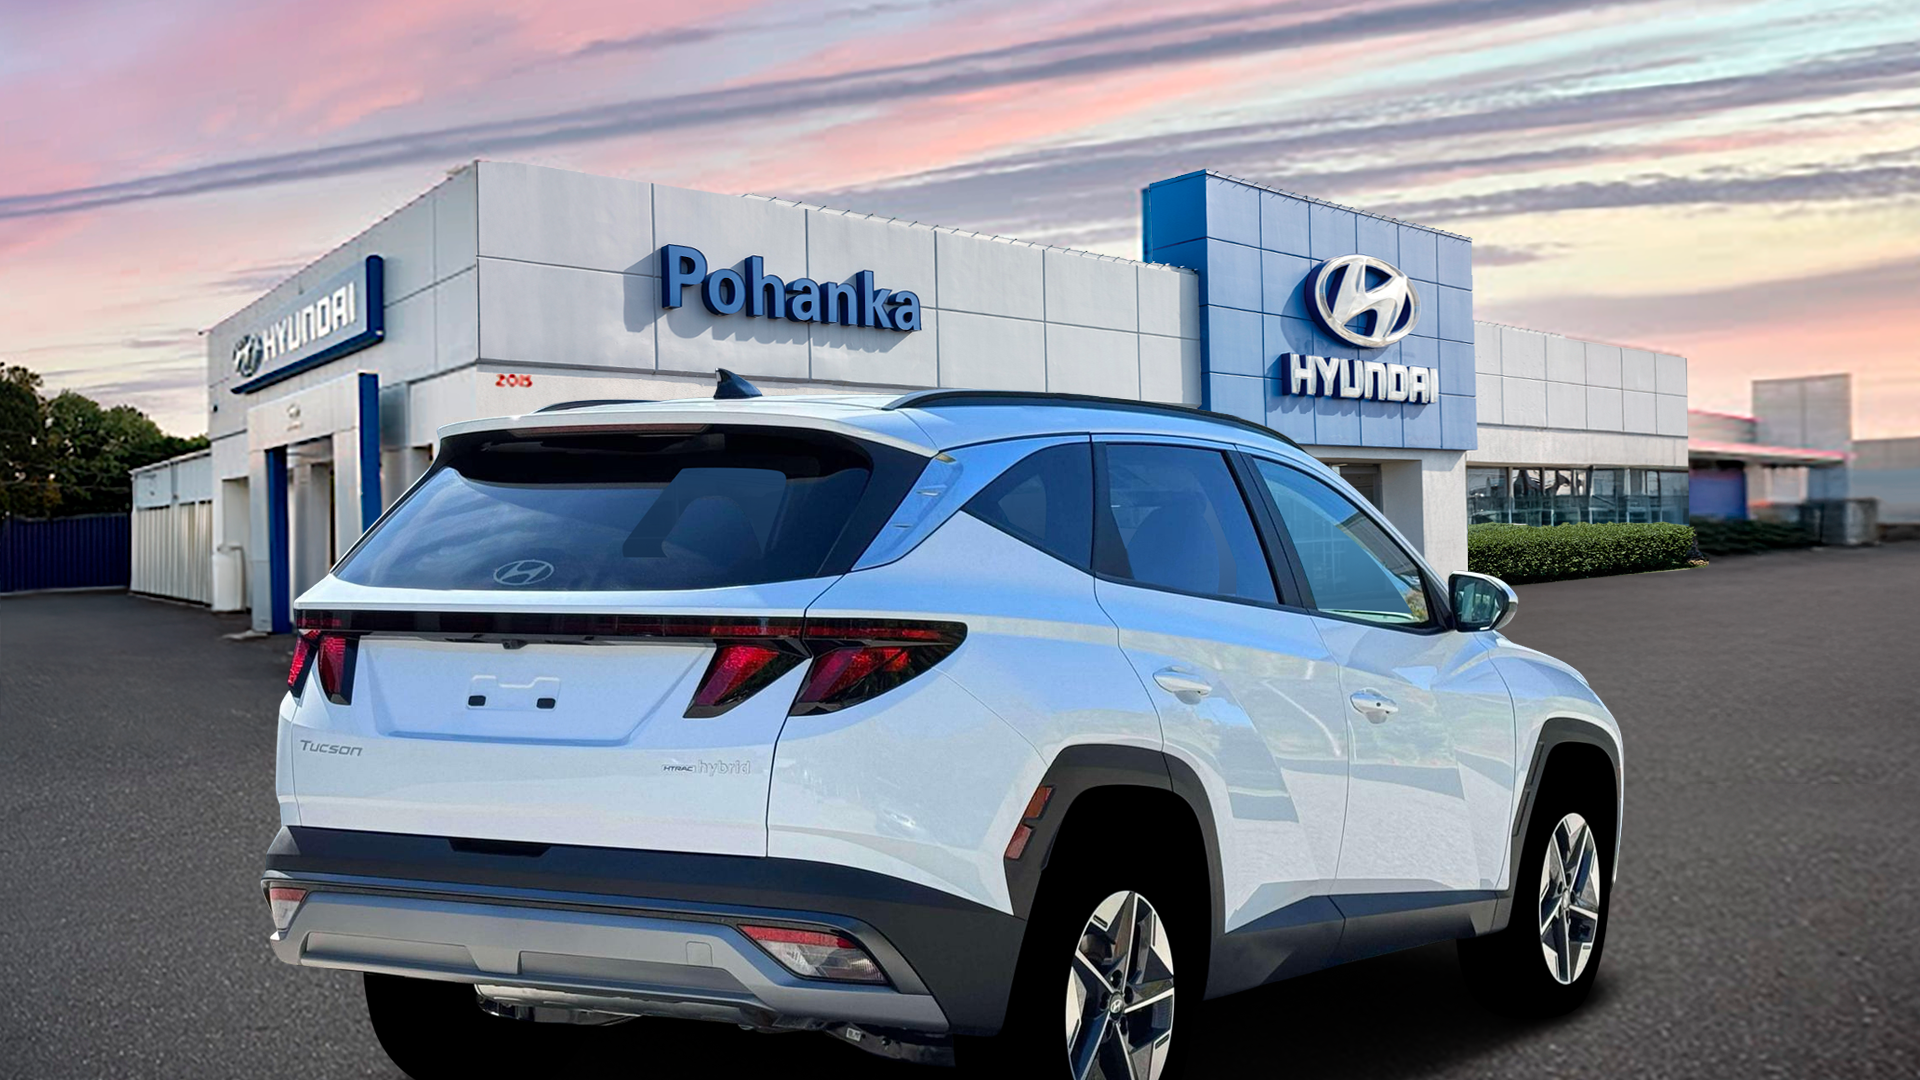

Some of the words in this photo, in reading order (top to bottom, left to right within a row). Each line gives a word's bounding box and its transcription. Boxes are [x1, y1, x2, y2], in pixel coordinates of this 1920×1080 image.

[661, 244, 922, 332] Pohanka
[262, 282, 356, 361] HYUNDAI
[1282, 352, 1440, 404] HYUNDAI
[698, 759, 751, 777] hybrid
